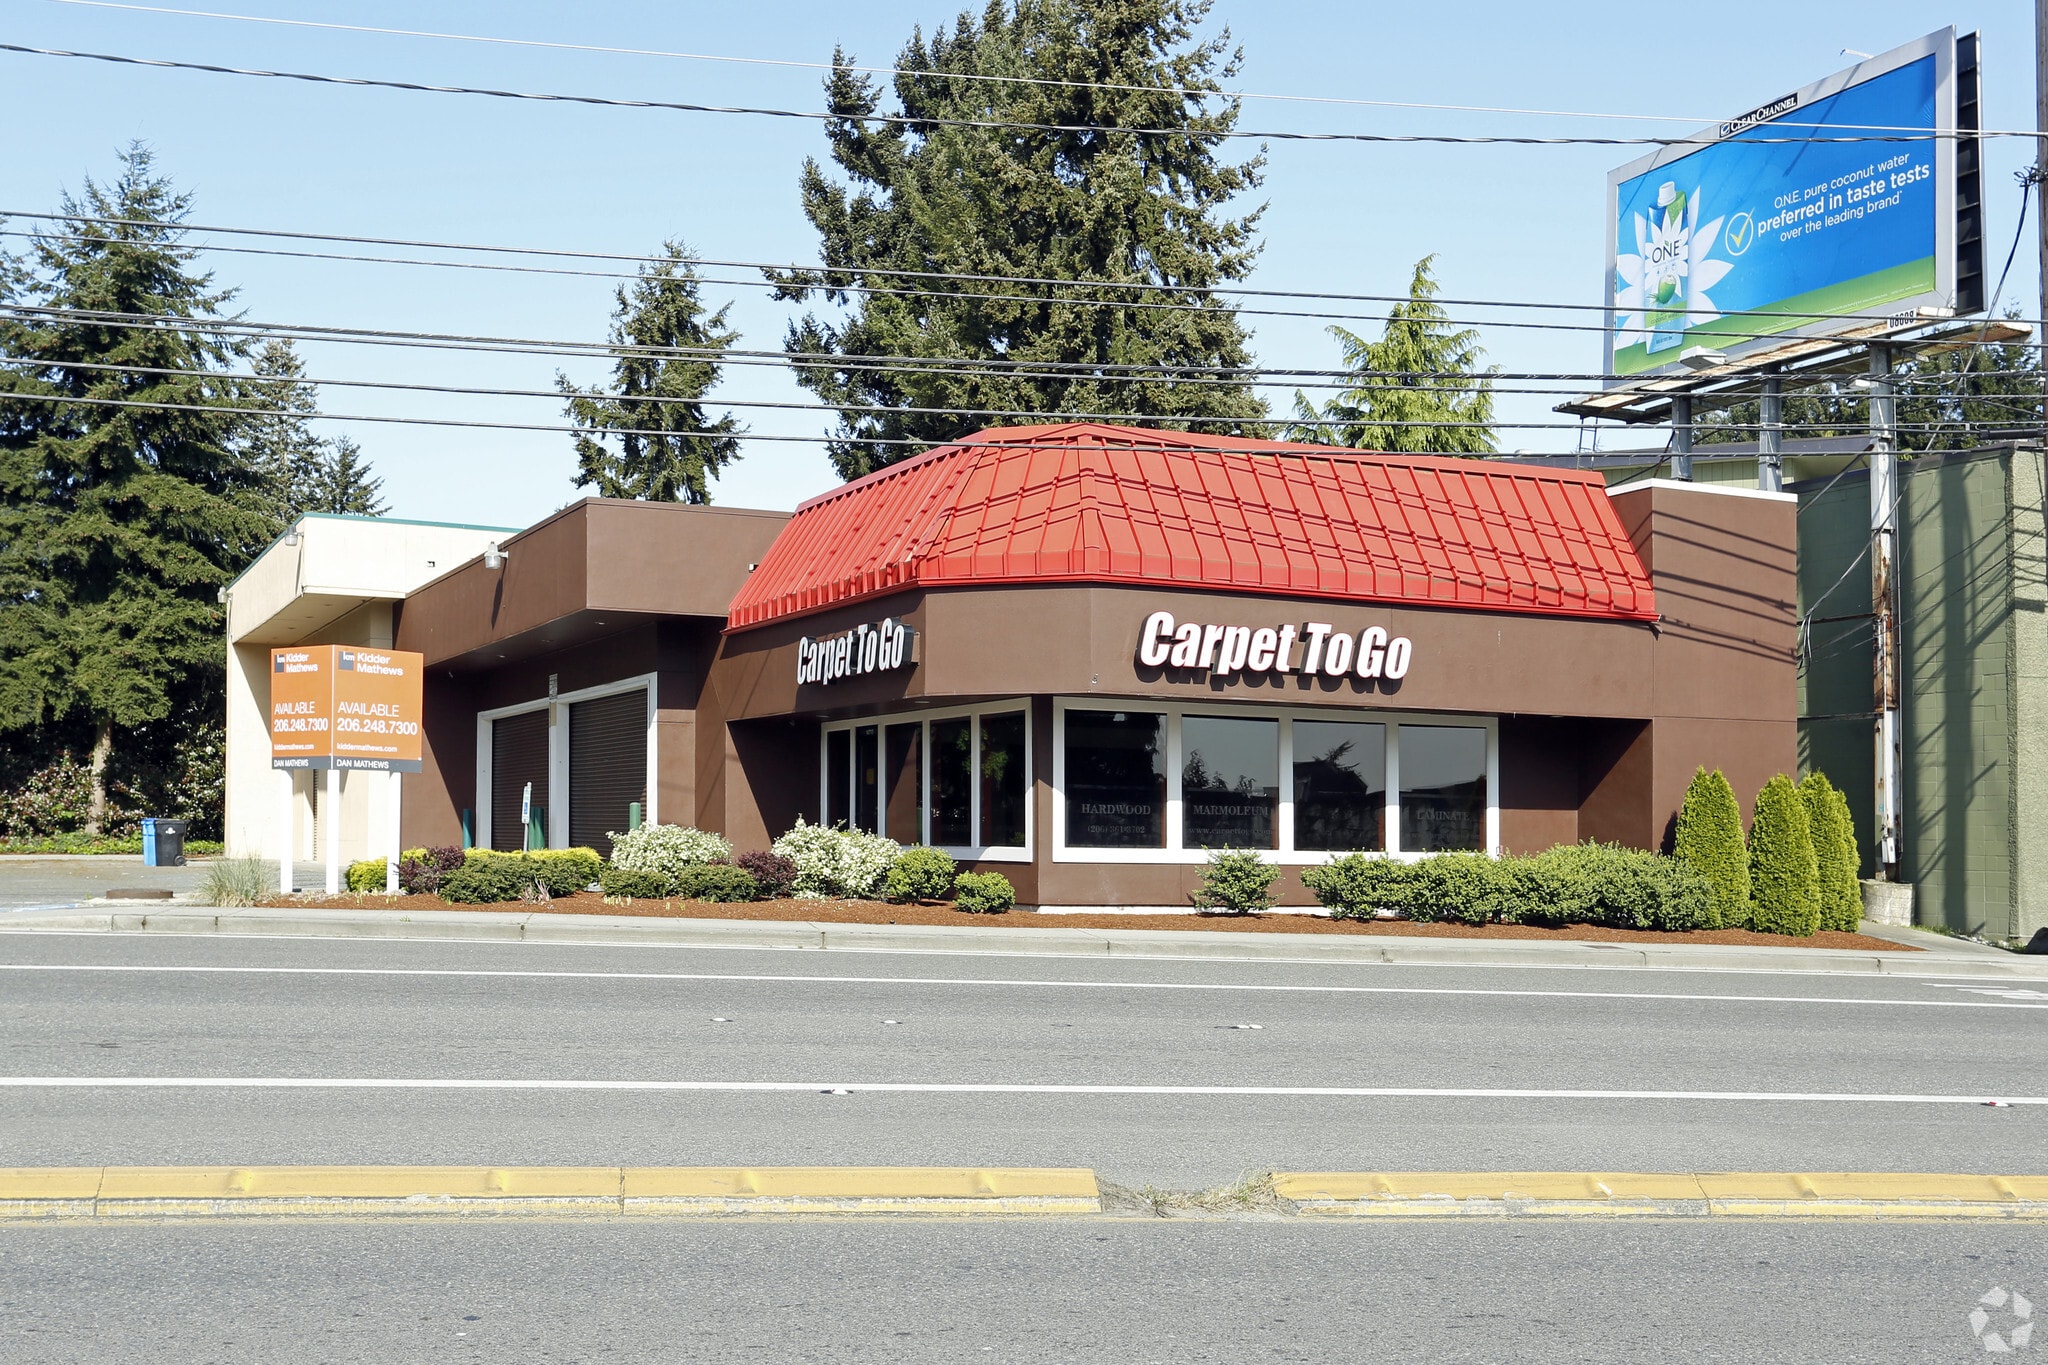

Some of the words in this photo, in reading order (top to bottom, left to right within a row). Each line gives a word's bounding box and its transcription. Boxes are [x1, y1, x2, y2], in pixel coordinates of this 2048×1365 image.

[1774, 189, 1802, 209] O.N.E.
[1804, 182, 1828, 201] pure
[1830, 164, 1875, 190] coconut
[1877, 152, 1910, 173] water
[1757, 199, 1825, 237] preferred
[1828, 193, 1843, 211] in
[1846, 180, 1886, 204] taste
[1890, 164, 1930, 189] tests
[1779, 226, 1802, 242] over
[1805, 218, 1822, 234] the
[1824, 204, 1864, 228] leading
[1651, 240, 1681, 264] ONE
[797, 630, 854, 686] Carpet
[856, 623, 878, 674] To
[879, 617, 905, 671] Go
[1139, 610, 1297, 677] Carpet
[1303, 621, 1354, 677] To
[1356, 625, 1413, 680] Go
[285, 653, 310, 663] Kidder
[357, 652, 391, 665] Kidder
[285, 663, 319, 673] Mathews
[357, 663, 404, 676] Mathews
[274, 701, 316, 715] AVAILABLE
[337, 702, 400, 718] AVAILABLE
[274, 717, 329, 733] 206.248.7300
[336, 717, 418, 736] 206.248.7300
[336, 743, 398, 753] kiddermathews.com
[273, 759, 285, 767] DAN
[285, 758, 309, 767] MATHEWS
[336, 758, 352, 768] DAN
[353, 760, 390, 770] MATHEWS
[1081, 803, 1151, 815] HARDWOOD
[1192, 804, 1269, 817] MARMOLEUM
